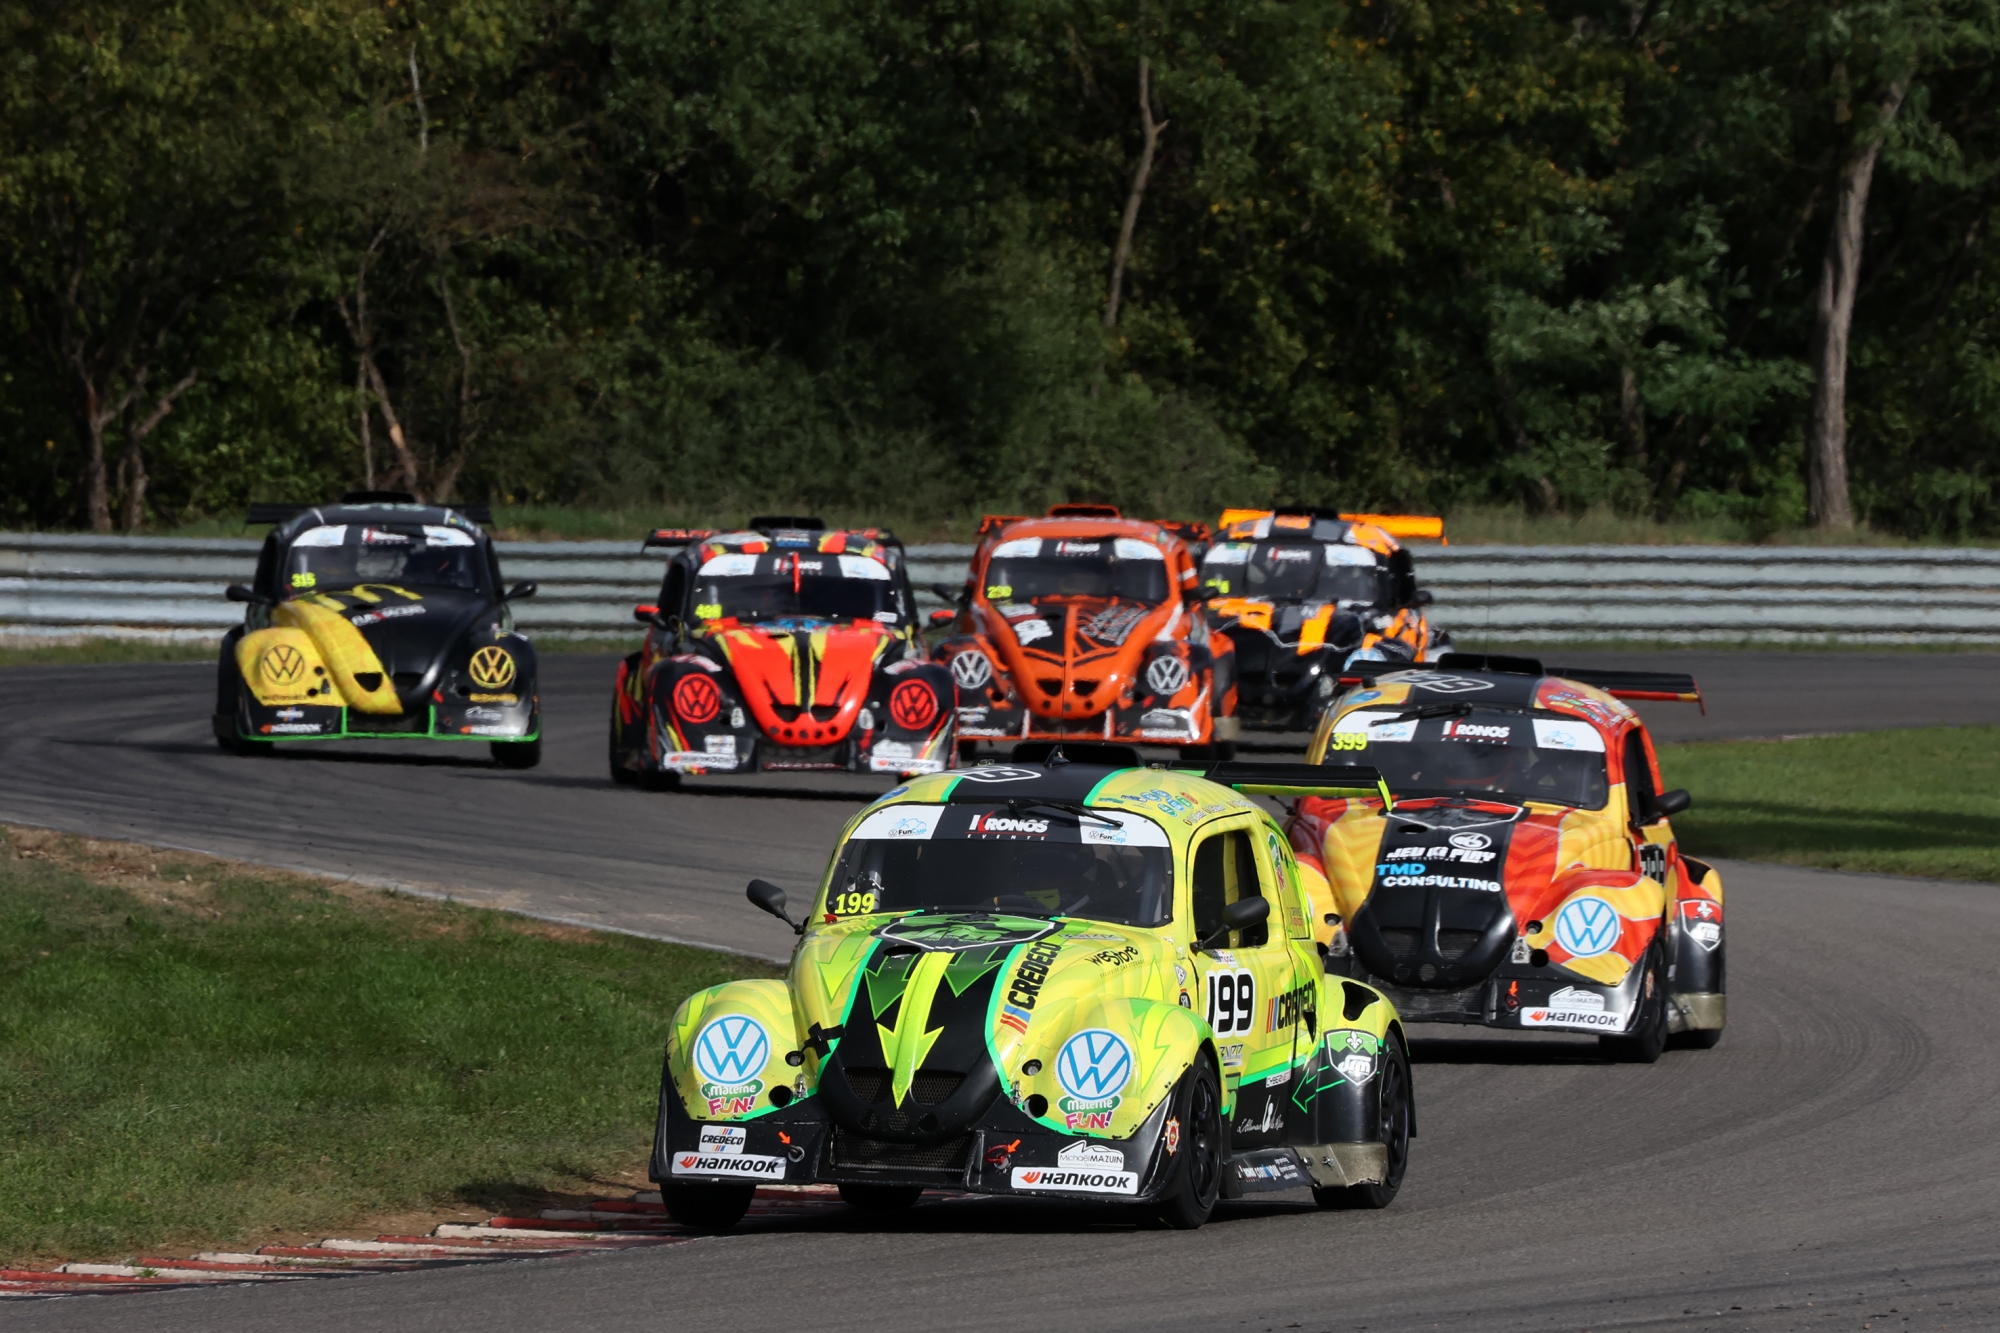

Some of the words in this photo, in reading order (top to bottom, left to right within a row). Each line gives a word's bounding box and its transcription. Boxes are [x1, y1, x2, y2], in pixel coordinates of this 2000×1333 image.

[1441, 718, 1510, 738] KRONOS
[1331, 732, 1368, 751] 399
[969, 811, 1050, 833] KRONOS
[1376, 863, 1426, 875] TMD
[1383, 875, 1502, 892] CONSULTING
[835, 892, 875, 914] 199
[1557, 898, 1618, 956] VW
[1007, 941, 1062, 1011] CREDECO
[1207, 974, 1254, 1032] 199
[696, 1015, 768, 1083] VW
[1058, 1030, 1131, 1101] VW
[708, 1096, 755, 1116] FUN!
[1065, 1111, 1113, 1130] FUN!
[701, 1134, 744, 1146] CREDECO
